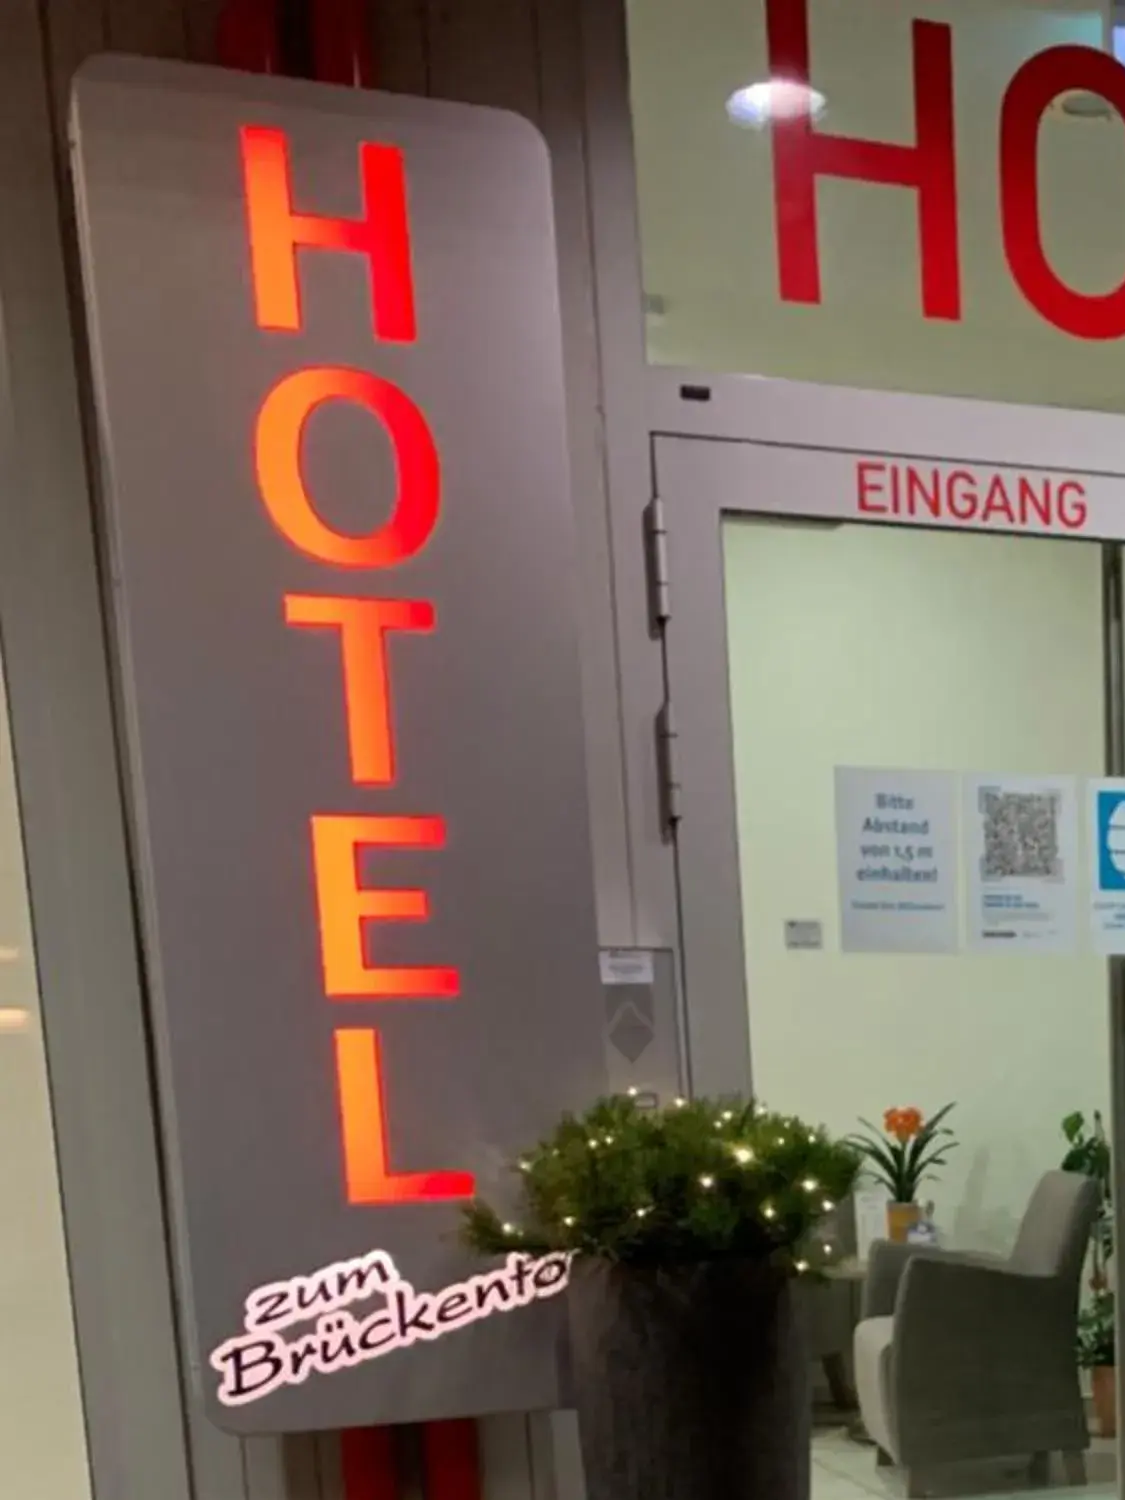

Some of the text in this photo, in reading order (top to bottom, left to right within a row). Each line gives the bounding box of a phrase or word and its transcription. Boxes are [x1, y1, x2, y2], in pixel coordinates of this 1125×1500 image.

[856, 460, 1087, 529] EINGANG
[239, 125, 475, 1204] HOTEL
[862, 817, 929, 835] Abstand
[876, 792, 914, 810] Bitte
[861, 845, 890, 859] von
[917, 846, 933, 858] m
[254, 1257, 390, 1325] zum
[220, 1256, 570, 1398] Brückento
